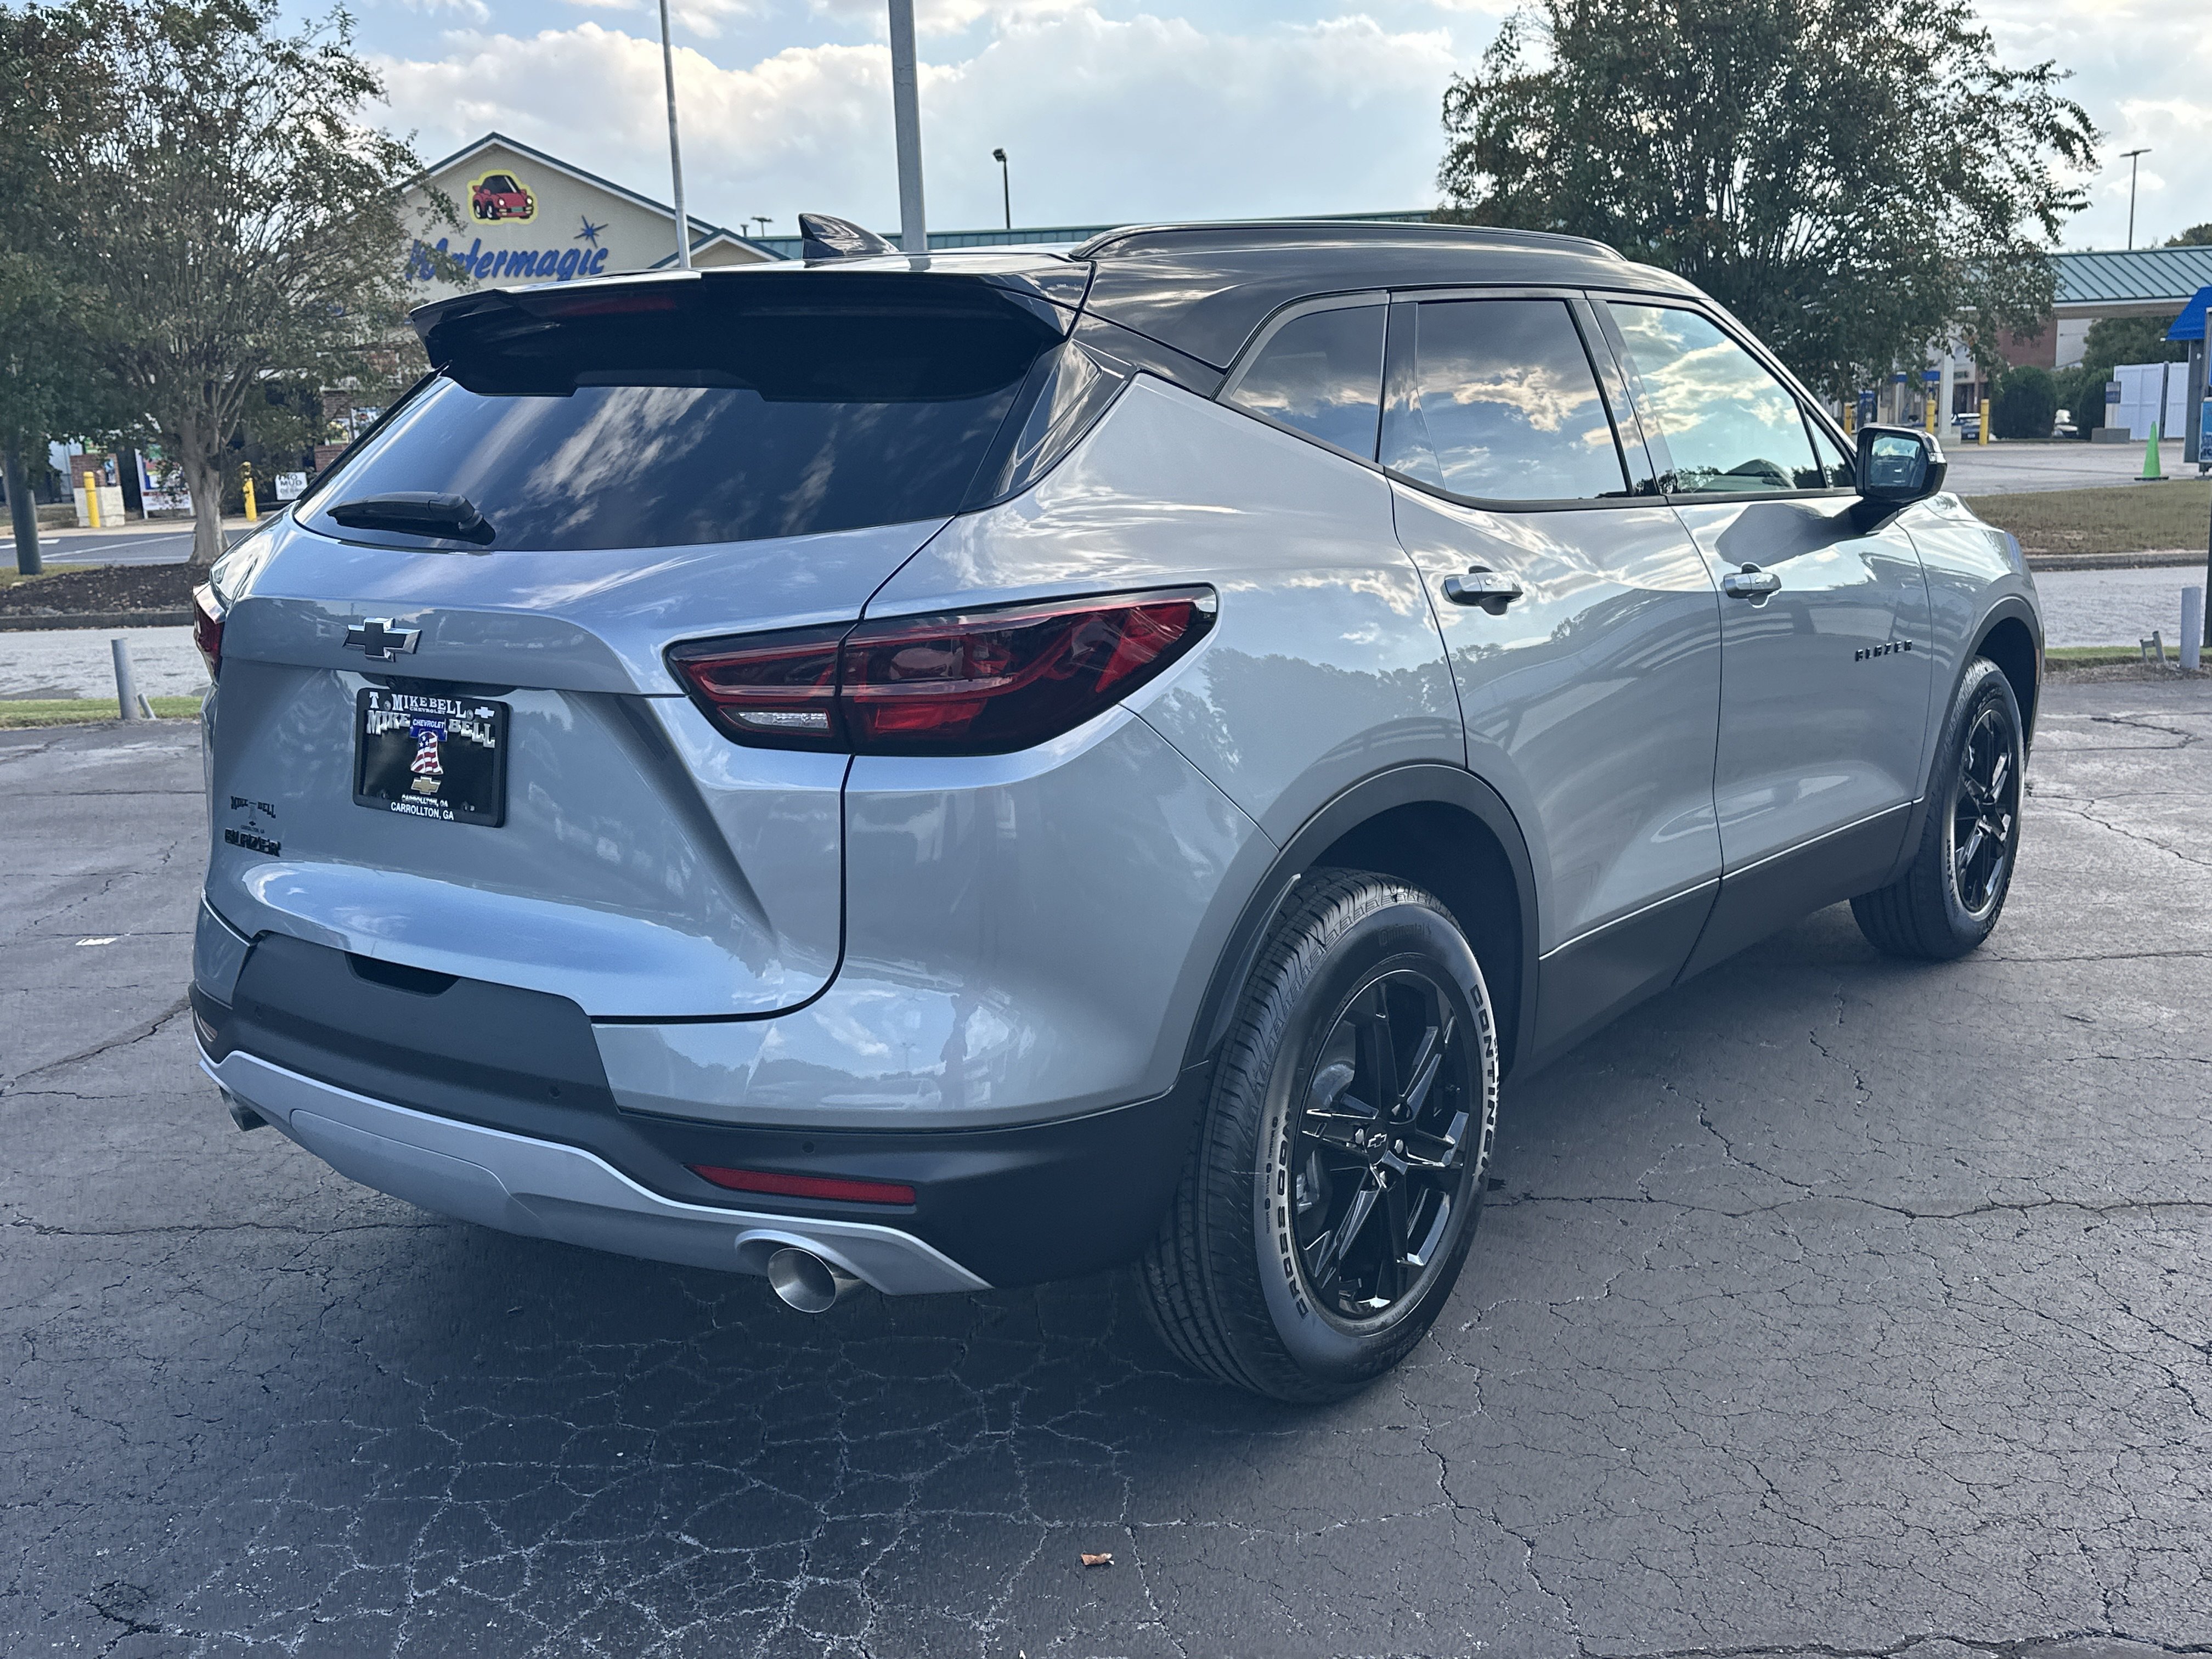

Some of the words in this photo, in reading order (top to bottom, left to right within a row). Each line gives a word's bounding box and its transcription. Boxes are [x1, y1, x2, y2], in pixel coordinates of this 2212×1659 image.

[391, 693, 427, 711] MIKE
[428, 697, 466, 719] BELL
[409, 707, 446, 715] CHEVROLET
[366, 709, 411, 735] MIKE
[448, 718, 495, 748] BELL
[413, 718, 445, 729] CHEVROLET
[257, 802, 276, 819] BELL
[391, 802, 442, 820] CARROLLTON,
[443, 809, 454, 820] GA
